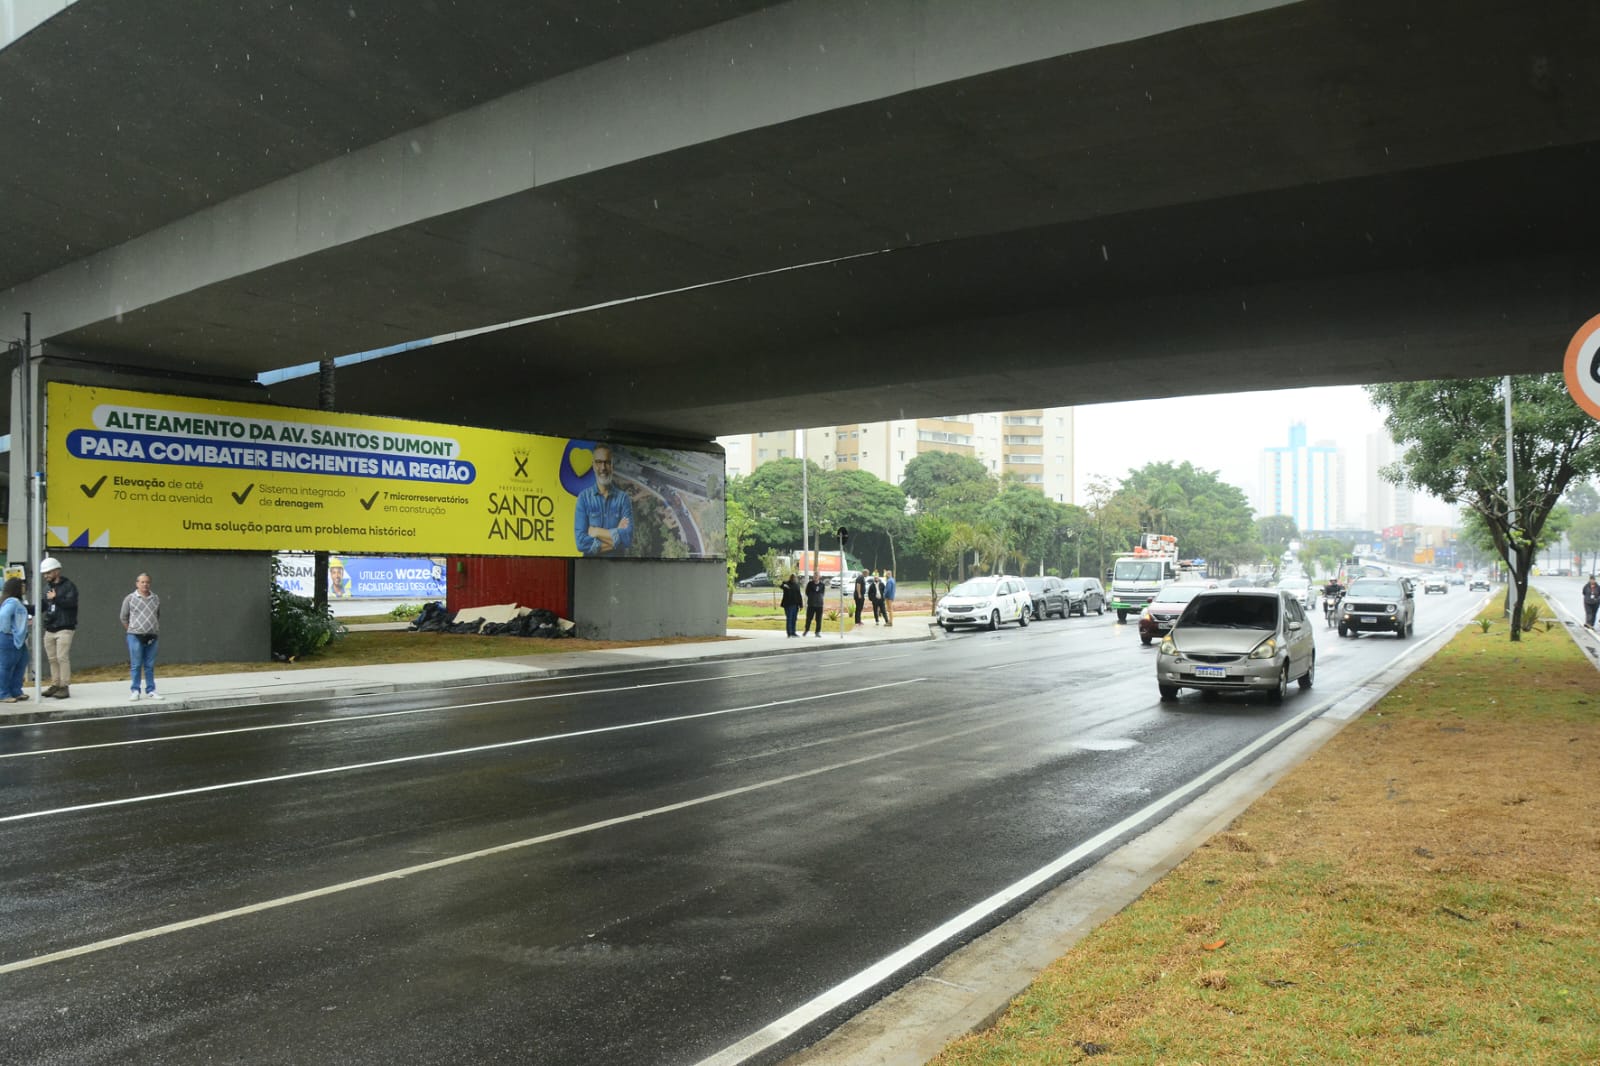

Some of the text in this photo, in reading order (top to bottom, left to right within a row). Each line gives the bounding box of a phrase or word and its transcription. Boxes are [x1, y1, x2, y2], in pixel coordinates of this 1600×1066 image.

[105, 410, 453, 457] ALTEAMENTO DA AV. SANTOS DUMONT
[80, 436, 470, 481] PARA COMBATER ENCHENTES NA REGIÃO
[113, 475, 204, 490] Elevação de até
[113, 490, 213, 504] 70 cm da avenida
[259, 484, 346, 498] Sistema integrado
[383, 492, 469, 504] 7 microrreservatórios
[259, 498, 324, 510] de drenagem
[399, 505, 447, 516] construção
[487, 492, 554, 517] SANTO
[182, 519, 416, 537] Uma solução para um problema histórico!
[487, 516, 555, 542] ANDRÉ
[360, 570, 385, 581] UTILIZE
[395, 567, 431, 581] waze
[358, 583, 395, 592] FACILITAR
